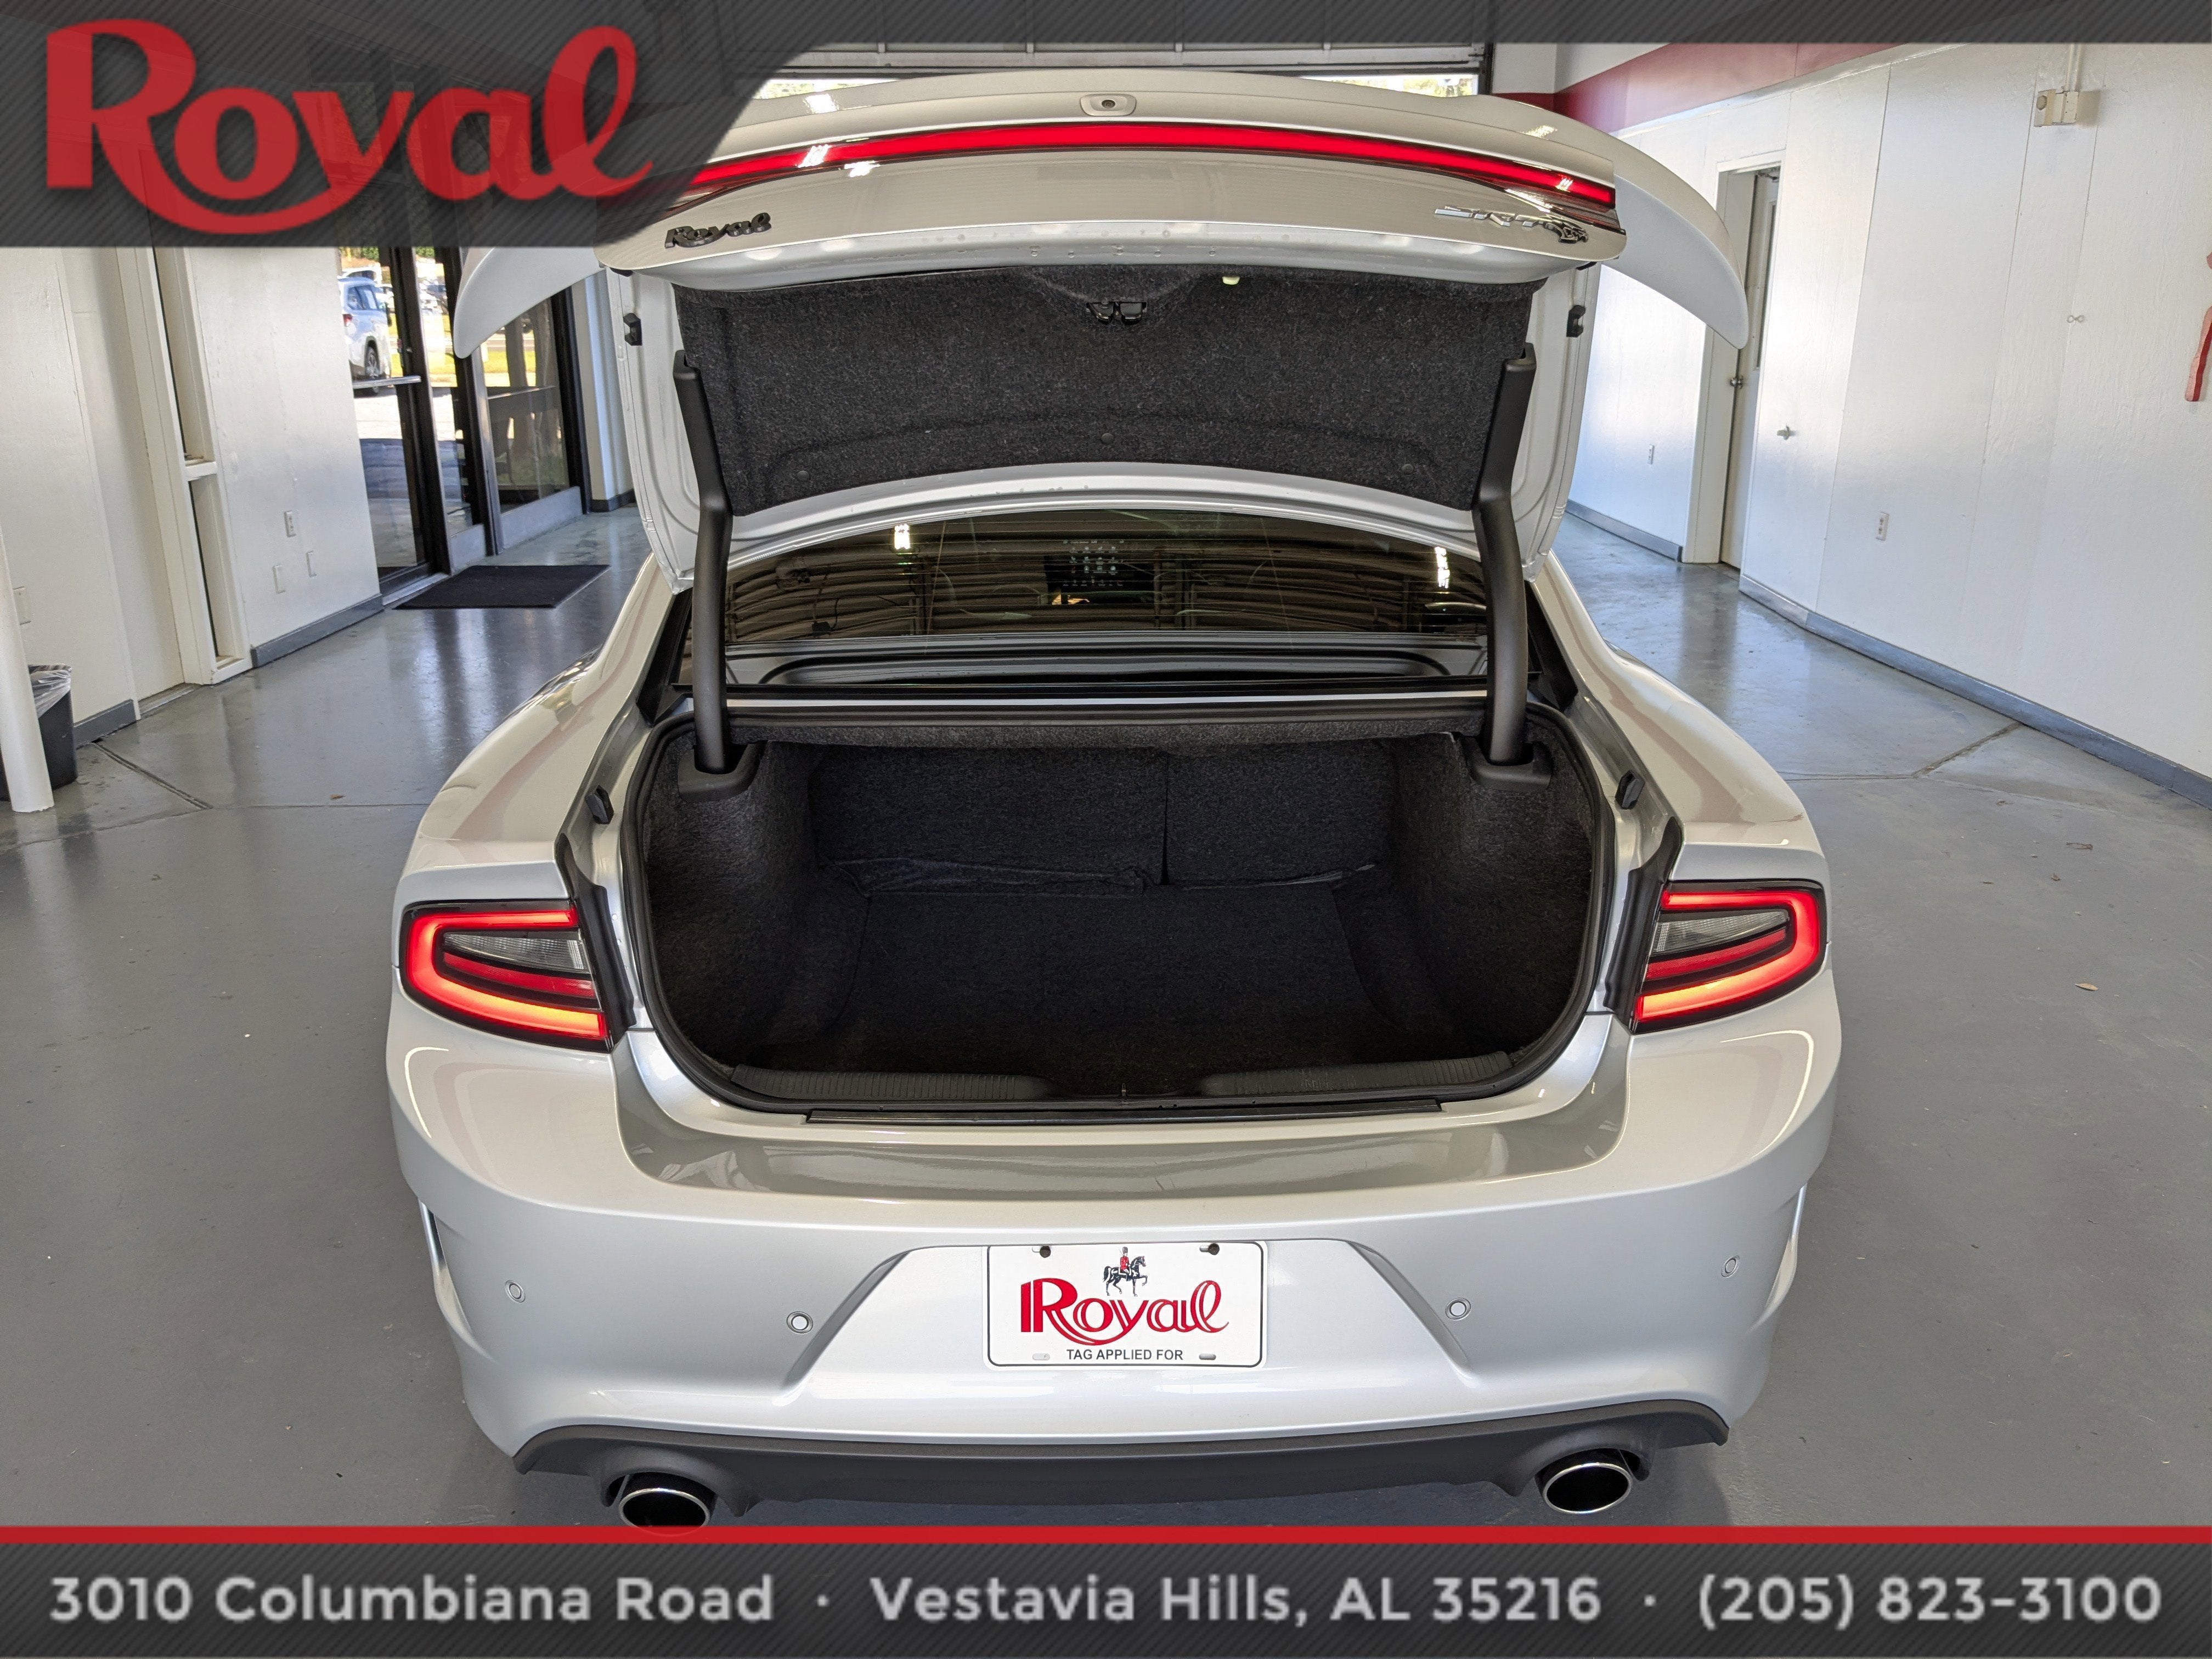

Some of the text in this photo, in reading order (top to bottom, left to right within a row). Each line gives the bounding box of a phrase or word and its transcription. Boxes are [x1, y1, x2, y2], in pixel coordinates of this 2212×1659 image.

[664, 212, 772, 249] Royal
[1020, 1278, 1229, 1346] Royal
[1066, 1349, 1183, 1360] TAG APPLIED FOR
